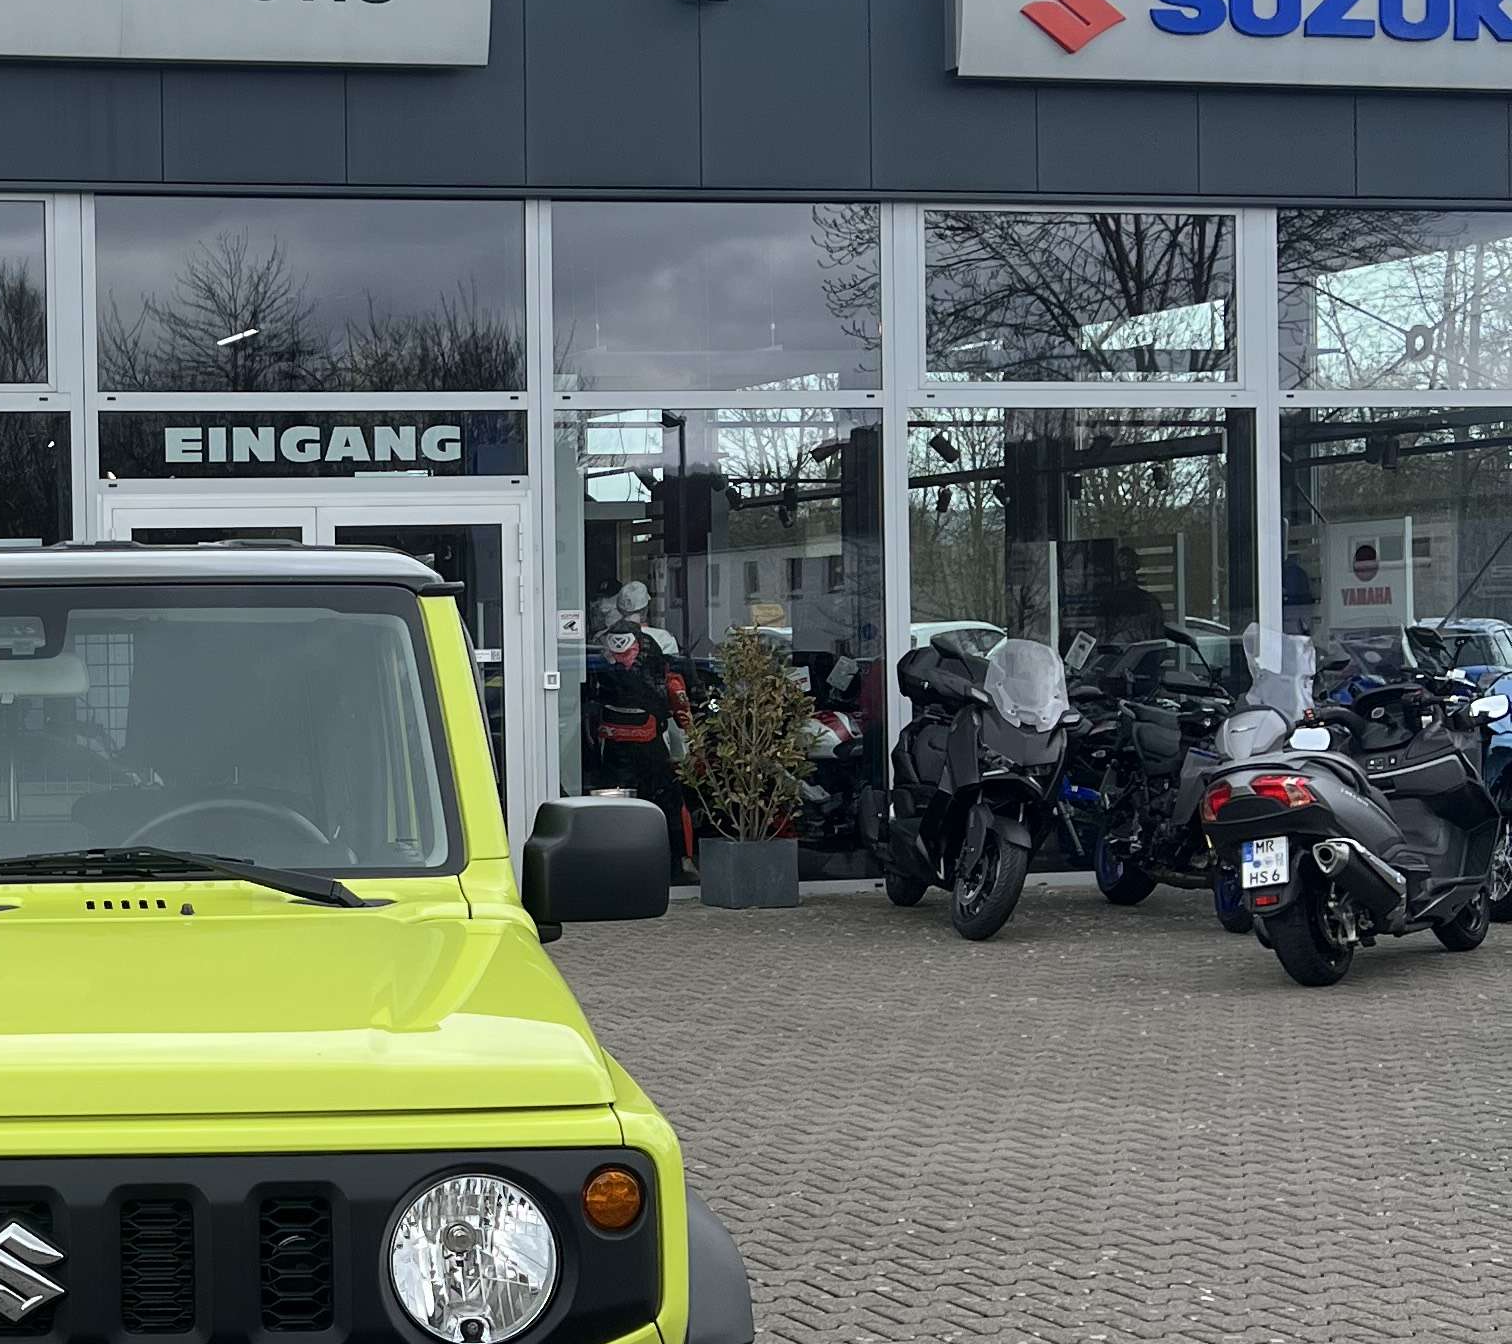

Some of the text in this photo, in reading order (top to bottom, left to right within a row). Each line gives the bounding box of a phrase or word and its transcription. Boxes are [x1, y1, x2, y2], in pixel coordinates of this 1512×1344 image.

[164, 425, 462, 463] EINGANG
[1256, 840, 1274, 854] MR
[1250, 869, 1280, 885] HS 6
